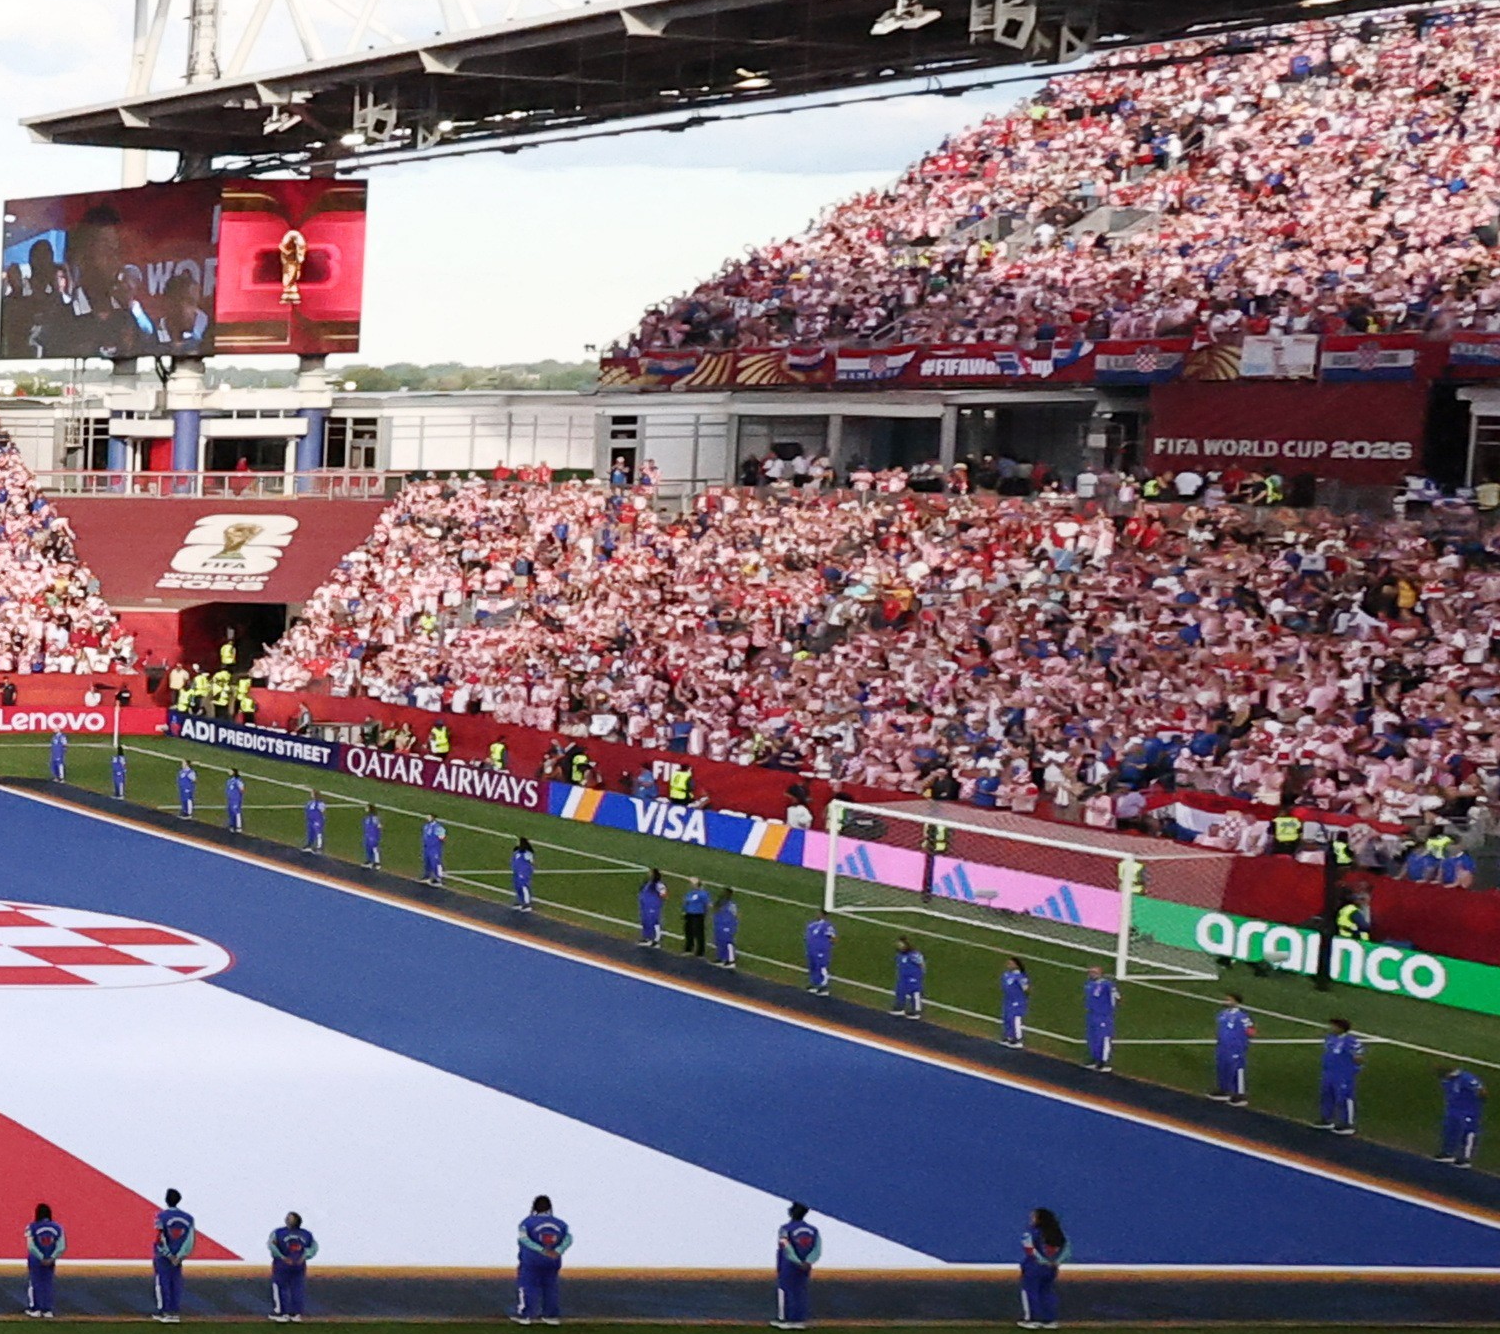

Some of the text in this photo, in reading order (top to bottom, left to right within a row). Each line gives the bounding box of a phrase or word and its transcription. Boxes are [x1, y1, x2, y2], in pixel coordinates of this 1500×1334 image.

[1153, 437, 1413, 460] FIFA WORLD CUP 2026
[163, 572, 270, 582] WORLD CUP
[201, 560, 246, 569] FIFA
[154, 578, 265, 592] 2026
[180, 718, 332, 766] ADI PREDICTSTREET
[346, 746, 539, 809] QATAR AIRWAYS
[630, 797, 707, 845] VISA
[1197, 912, 1446, 999] aramco
